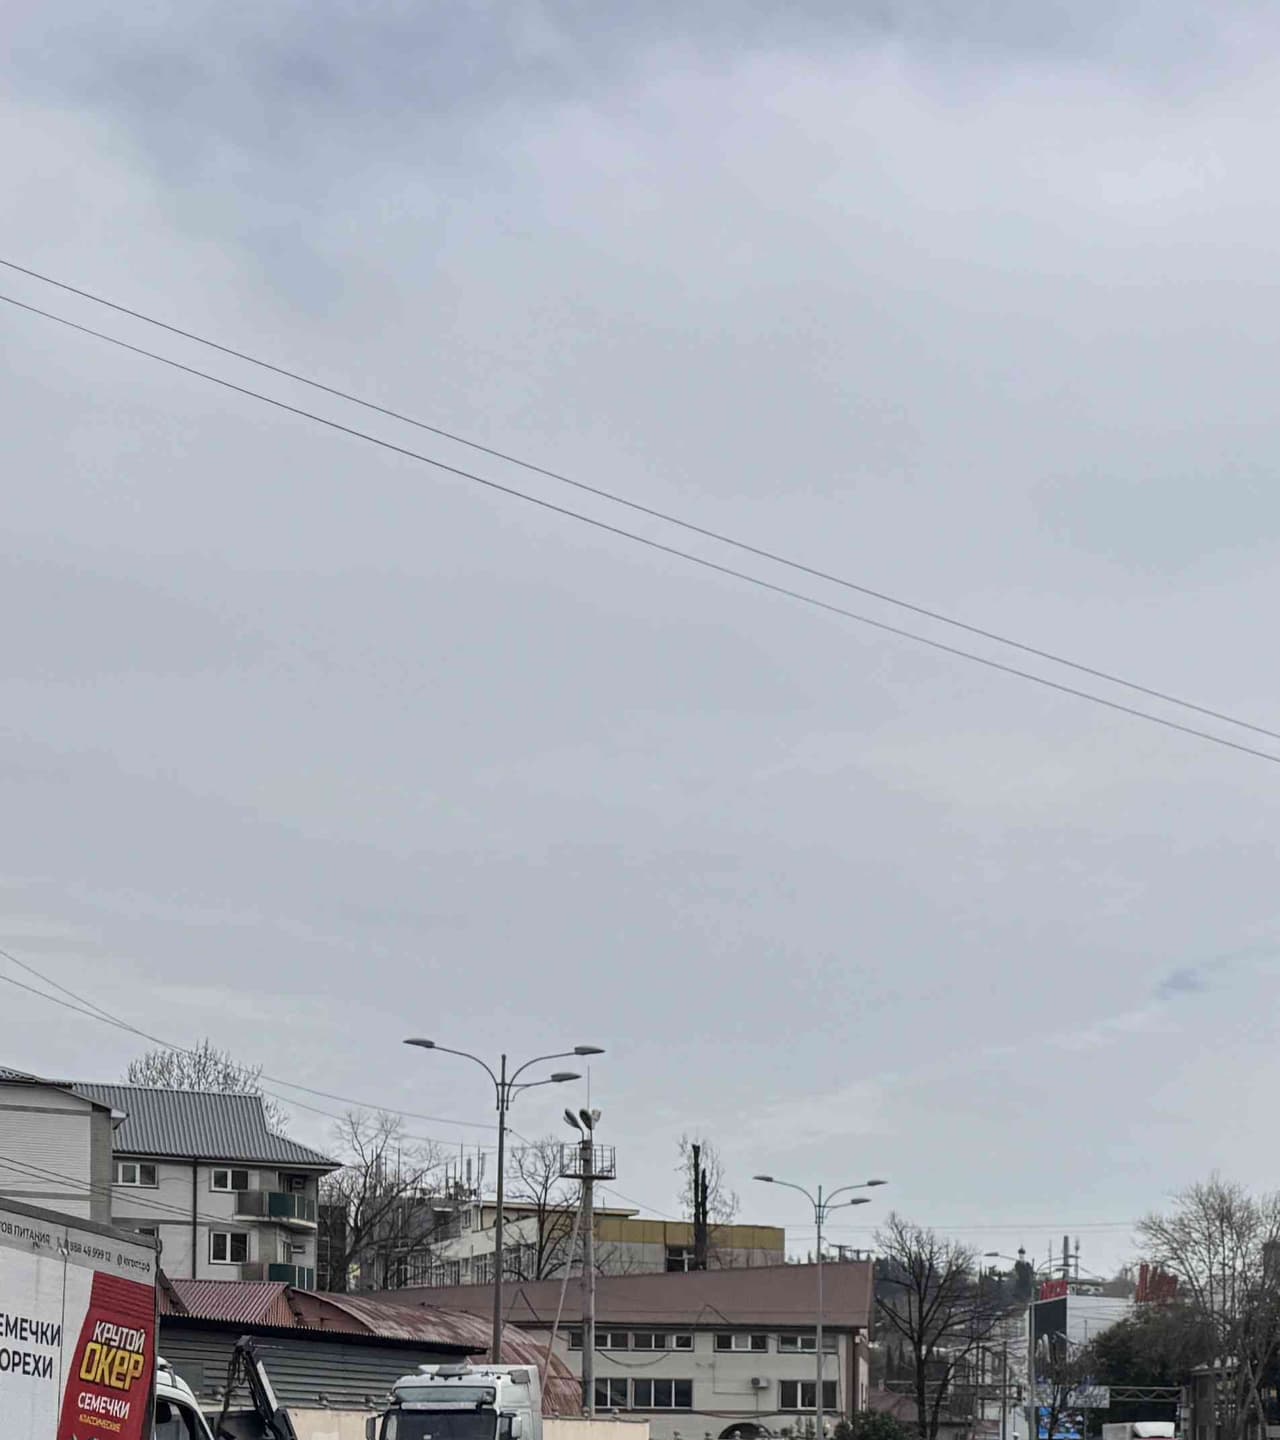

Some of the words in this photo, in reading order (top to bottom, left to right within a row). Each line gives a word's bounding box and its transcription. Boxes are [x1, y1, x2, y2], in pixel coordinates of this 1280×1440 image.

[14, 1225, 50, 1245] ПИТАНИЯ
[92, 1320, 146, 1353] КРУТОЙ
[0, 1348, 53, 1379] ОРЕХИ
[77, 1392, 130, 1420] СЕМЕЧКИ
